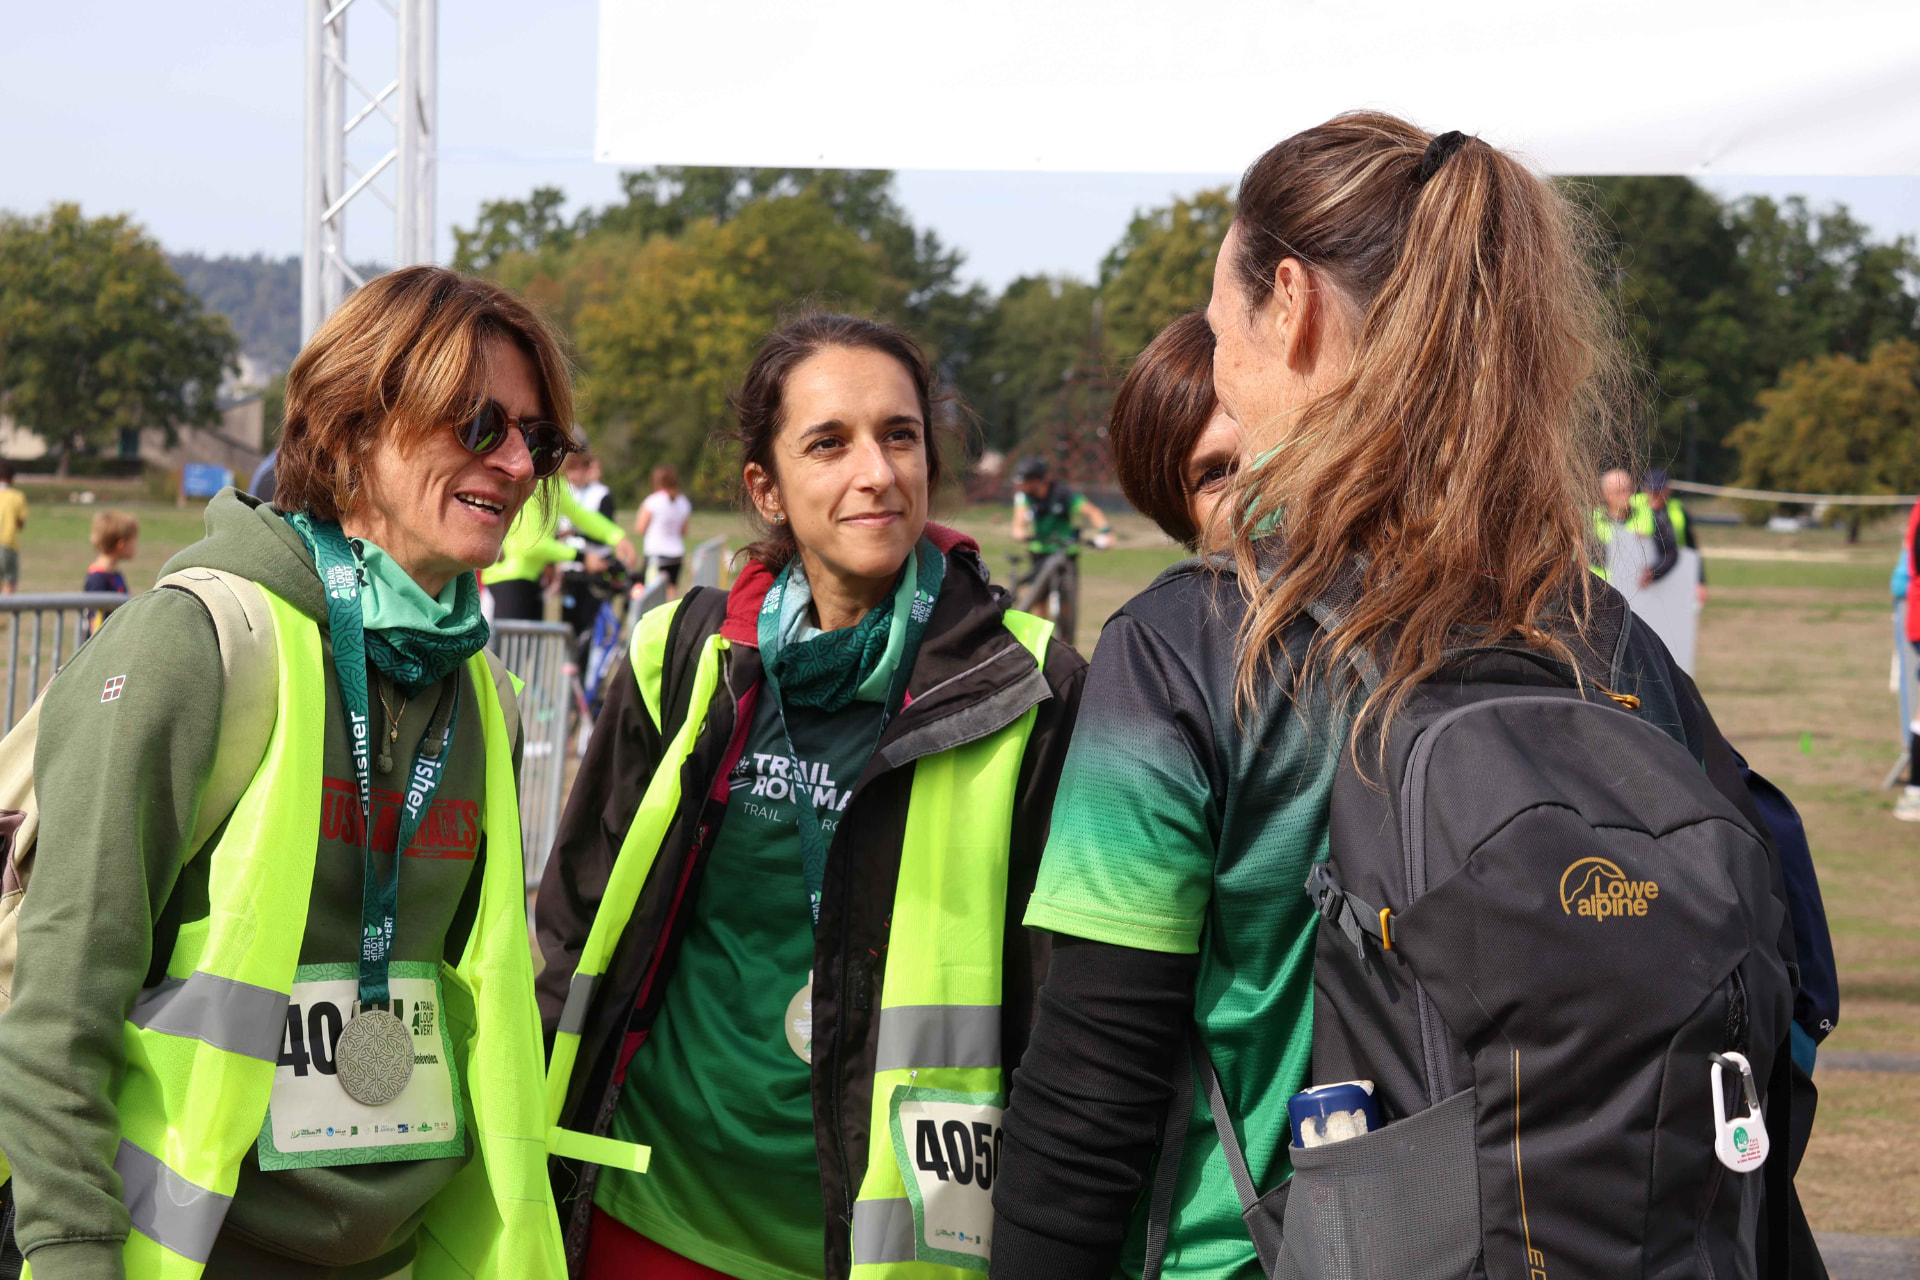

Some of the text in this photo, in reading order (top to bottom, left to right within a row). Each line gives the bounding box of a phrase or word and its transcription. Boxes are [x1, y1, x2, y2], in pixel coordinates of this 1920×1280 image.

[335, 566, 346, 589] LOUP
[344, 565, 355, 588] VERT
[743, 802, 782, 822] TRAIL
[1595, 875, 1659, 899] Lowe
[1577, 895, 1648, 922] alpine
[363, 937, 371, 962] VERT
[370, 937, 378, 962] LOUP
[420, 1012, 434, 1024] LOUP
[277, 998, 404, 1078] 40
[420, 1024, 434, 1036] VERT
